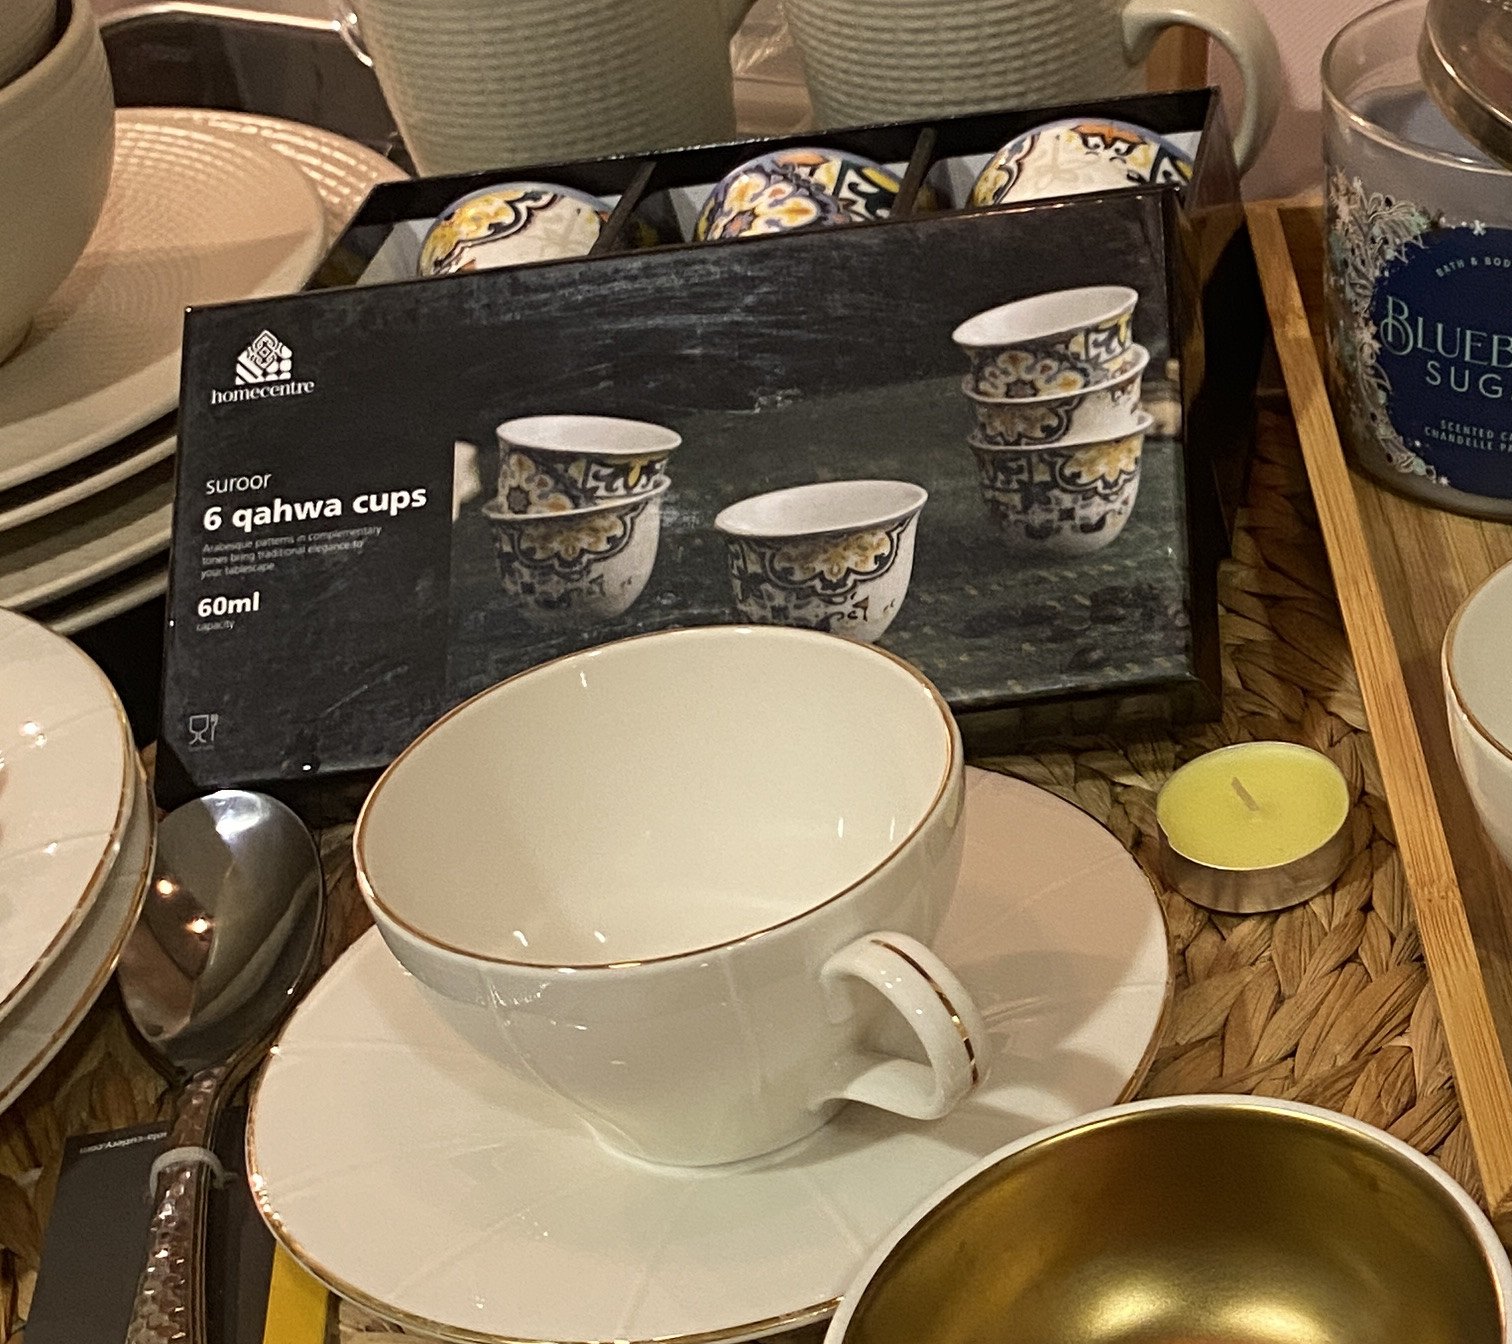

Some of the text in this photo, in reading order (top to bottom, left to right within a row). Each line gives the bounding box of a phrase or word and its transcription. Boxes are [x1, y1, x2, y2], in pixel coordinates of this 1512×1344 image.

[210, 379, 315, 405] homecentre
[205, 472, 272, 496] suroor
[203, 488, 428, 533] 6 qahwa cups
[197, 590, 261, 618] 60ml
